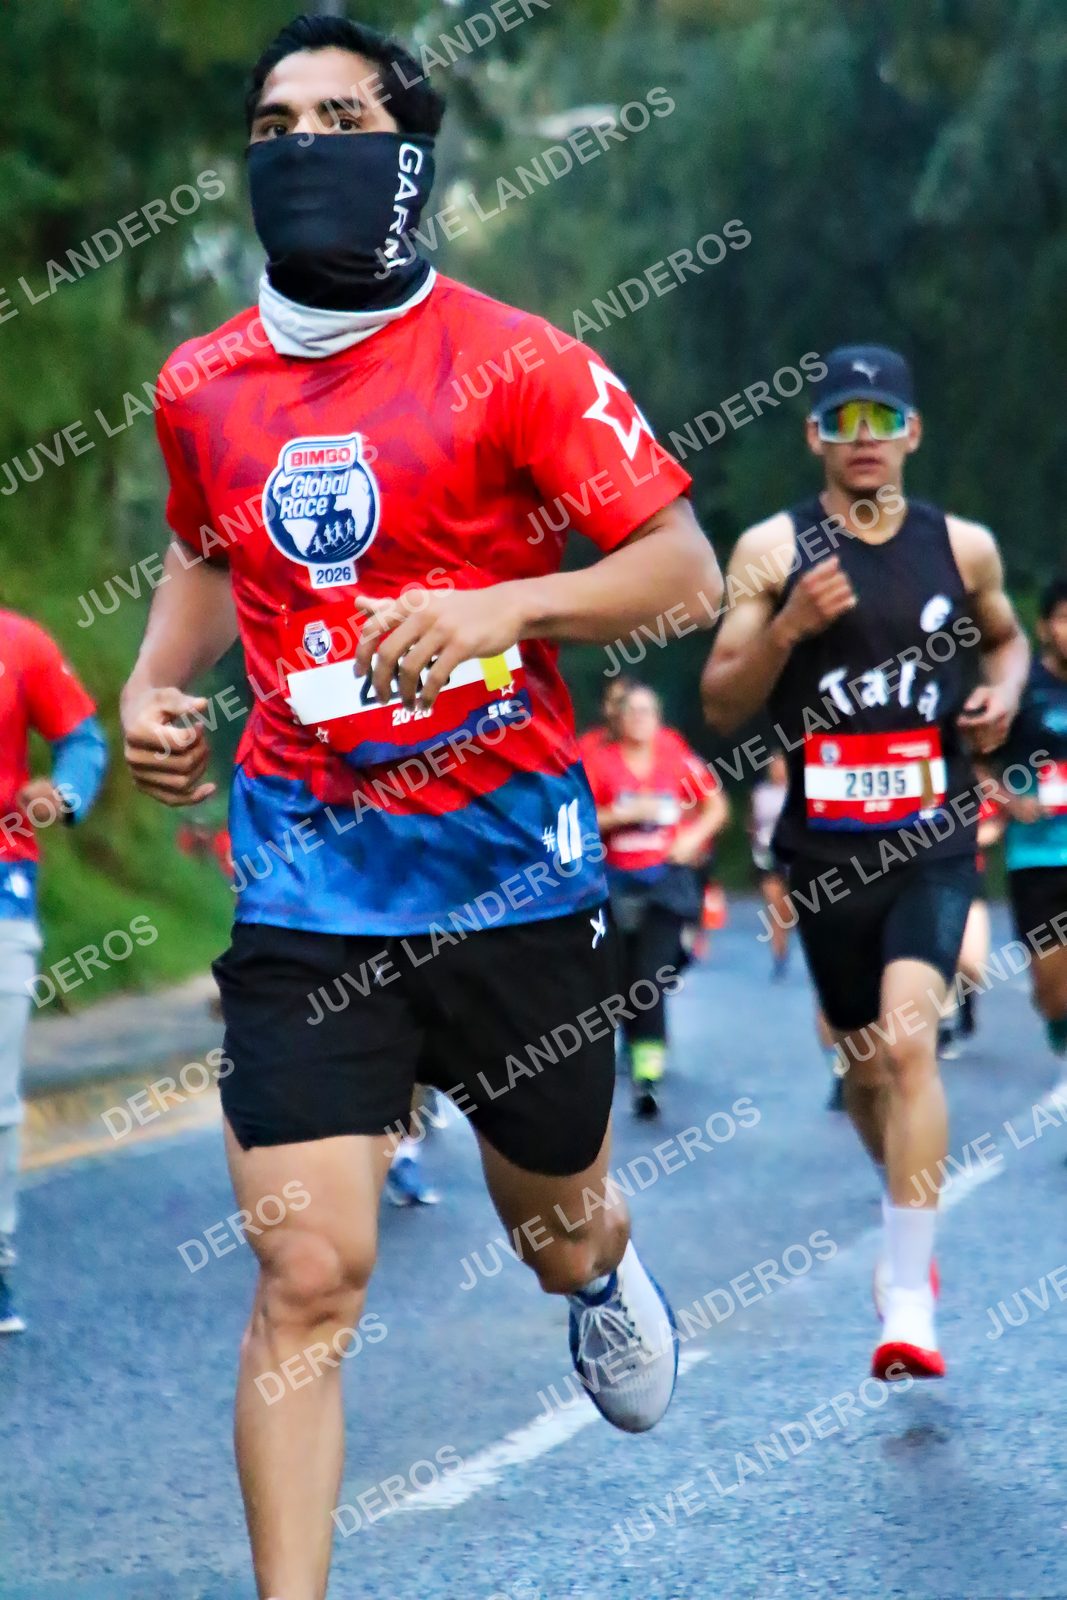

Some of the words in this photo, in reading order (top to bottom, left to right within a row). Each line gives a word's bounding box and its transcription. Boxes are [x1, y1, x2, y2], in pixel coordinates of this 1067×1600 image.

[290, 447, 351, 468] BIMBO
[290, 471, 349, 500] Global
[279, 497, 329, 519] Race
[316, 566, 351, 585] 2026
[845, 770, 906, 798] 2995
